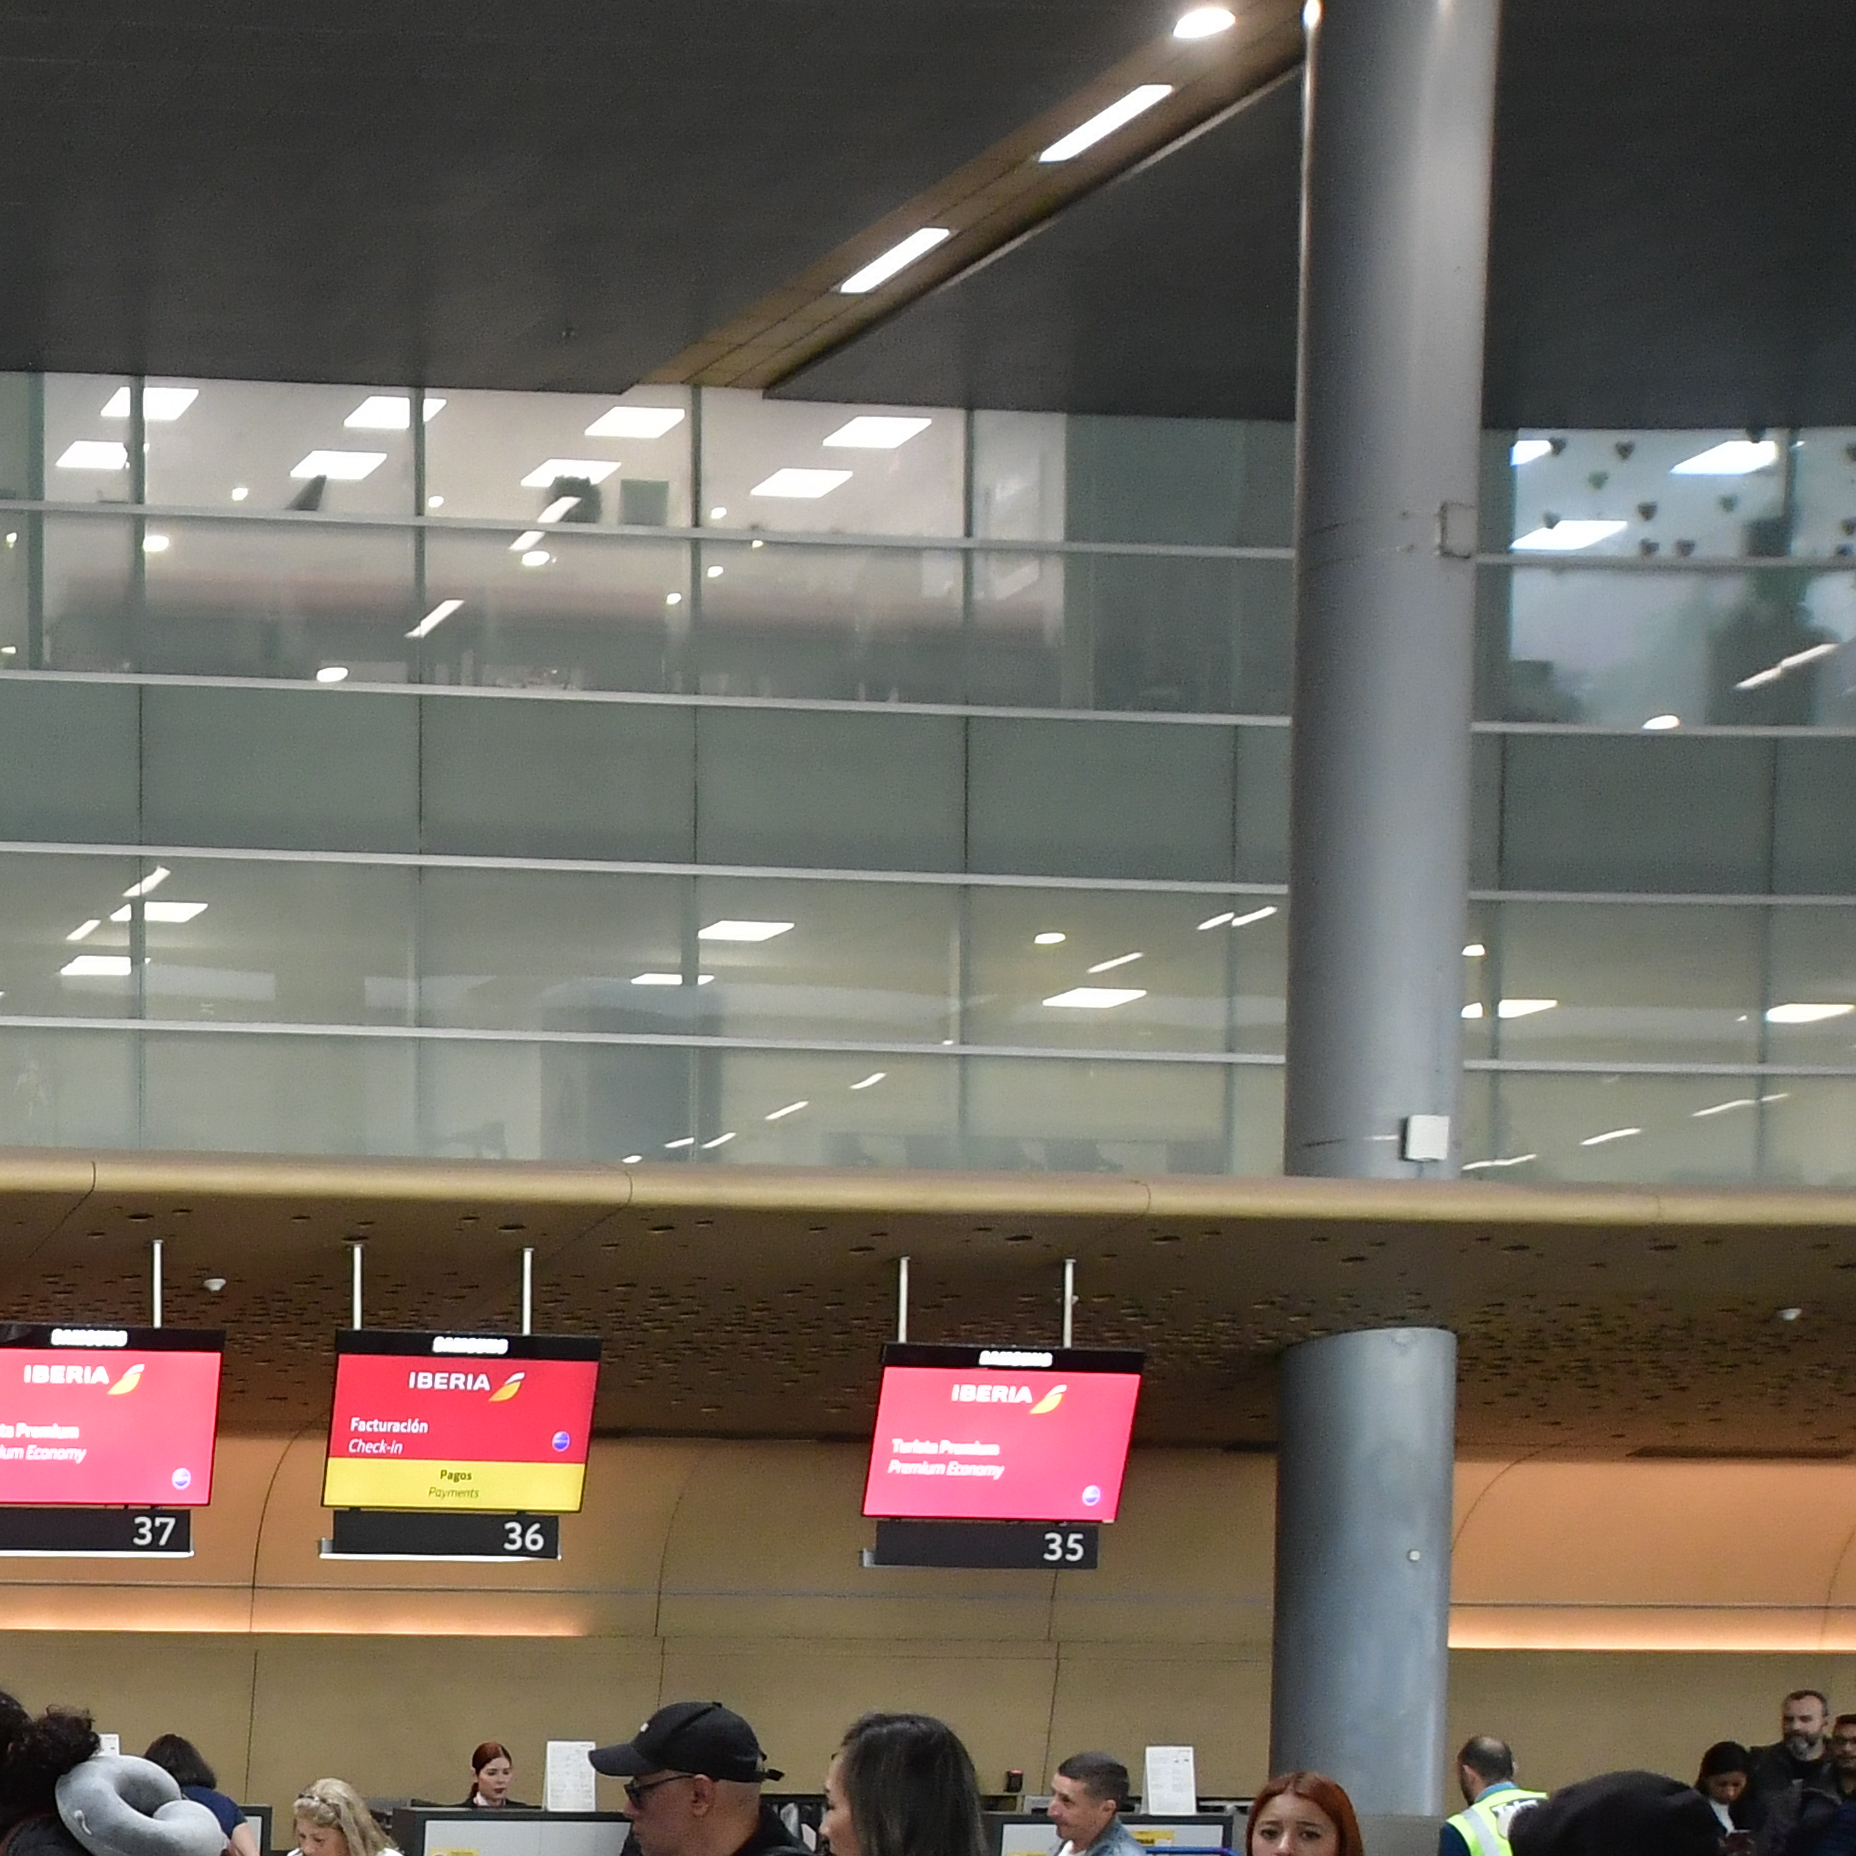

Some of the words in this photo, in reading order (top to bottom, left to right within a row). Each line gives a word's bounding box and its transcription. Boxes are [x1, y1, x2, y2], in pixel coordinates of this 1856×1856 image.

[24, 1365, 109, 1385] IBERIA
[408, 1372, 490, 1391] IBERIA
[951, 1384, 1033, 1404] IBERIA
[351, 1417, 428, 1434] Facturación
[25, 1445, 87, 1464] Economy
[348, 1439, 403, 1455] Check-in
[440, 1469, 473, 1483] Pagos
[888, 1460, 945, 1476] Premium
[946, 1461, 1005, 1480] Economy
[428, 1486, 479, 1500] Payments
[132, 1517, 175, 1546] 37
[503, 1522, 544, 1551] 36
[1043, 1533, 1084, 1562] 35
